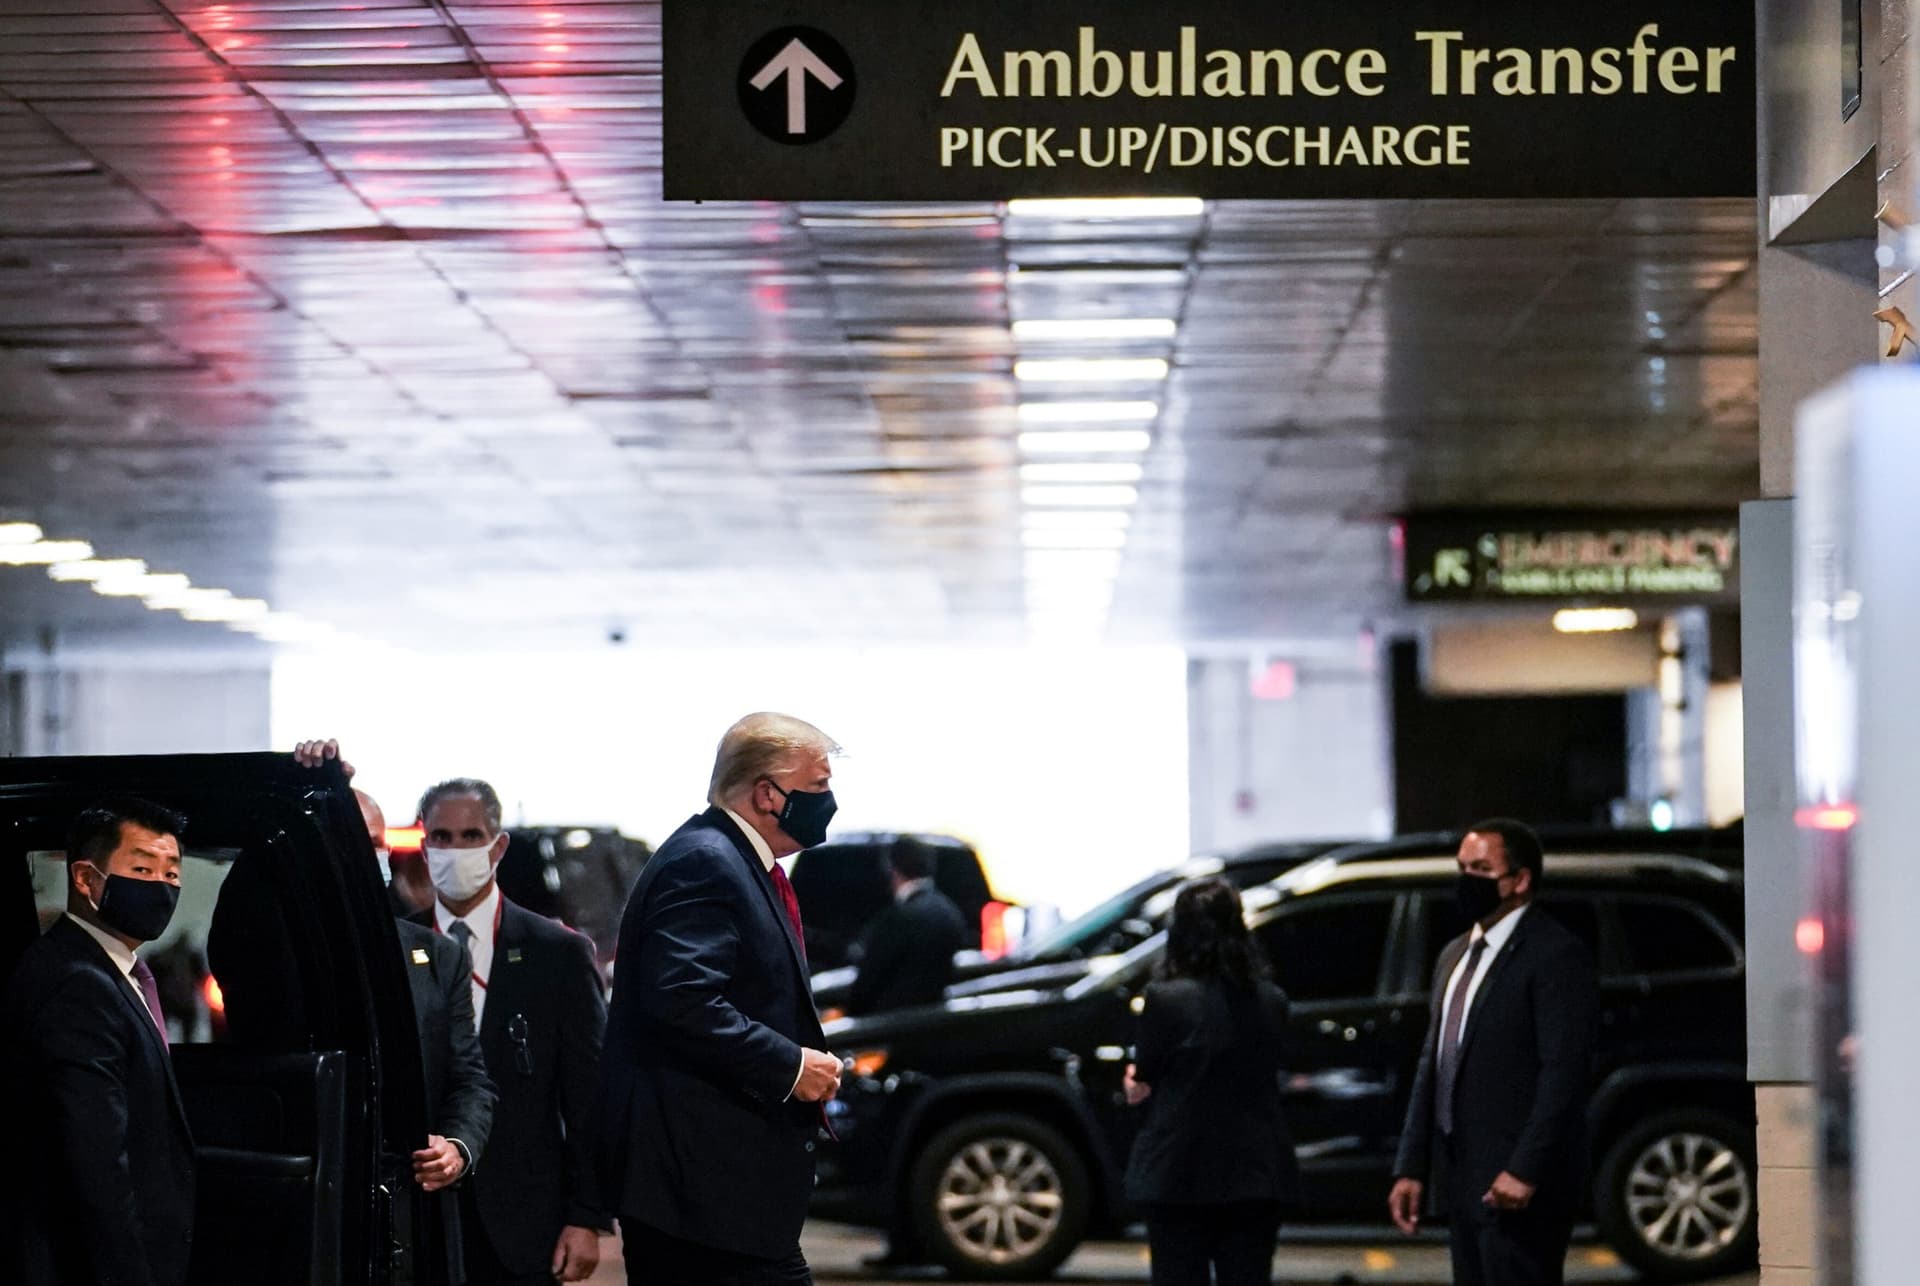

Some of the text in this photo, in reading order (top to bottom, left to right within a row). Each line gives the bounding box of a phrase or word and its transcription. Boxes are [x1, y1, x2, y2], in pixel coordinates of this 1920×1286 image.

[940, 23, 1737, 98] Ambulance Transfer
[940, 123, 1471, 174] PICK-UP/DISCHARGE
[1499, 529, 1737, 567] EMERGENCY
